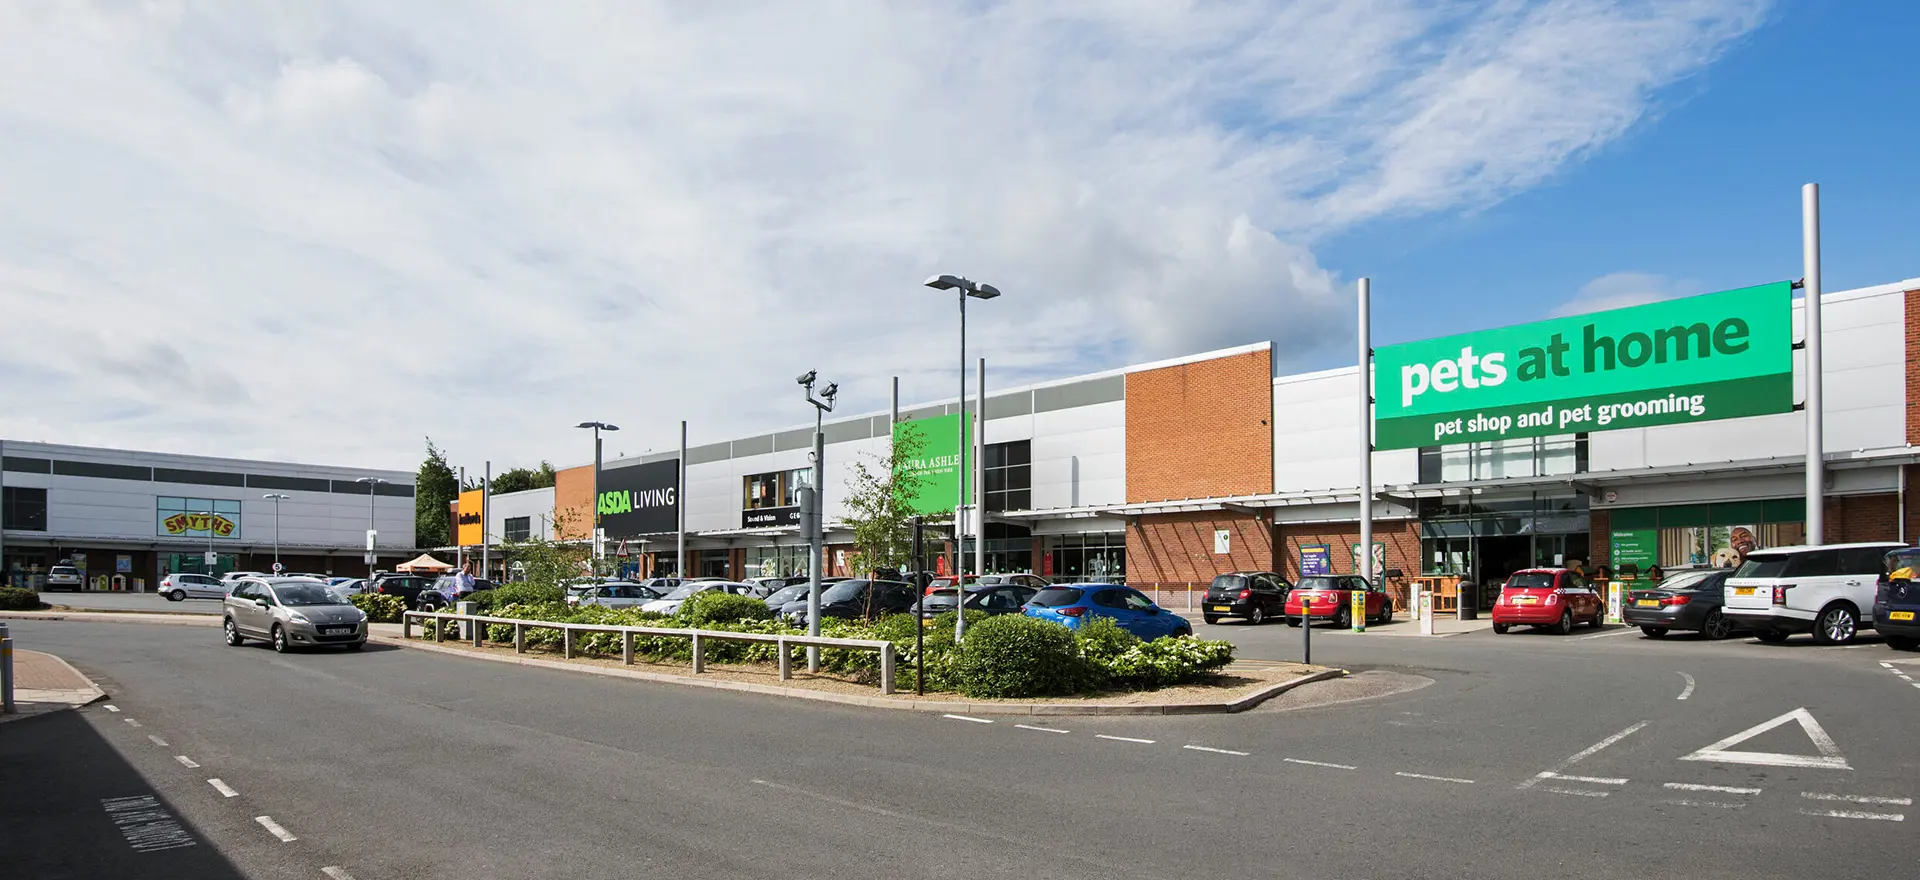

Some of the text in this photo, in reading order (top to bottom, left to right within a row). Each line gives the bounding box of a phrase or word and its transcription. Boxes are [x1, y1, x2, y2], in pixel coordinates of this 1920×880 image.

[1401, 317, 1750, 408] pets at home
[1434, 393, 1706, 441] pet shop and pet grooming
[929, 455, 959, 468] ASHLE
[597, 487, 675, 515] ASDA LIVING
[165, 514, 233, 534] SMYTHS
[747, 514, 760, 523] Sound
[764, 513, 777, 521] Vision
